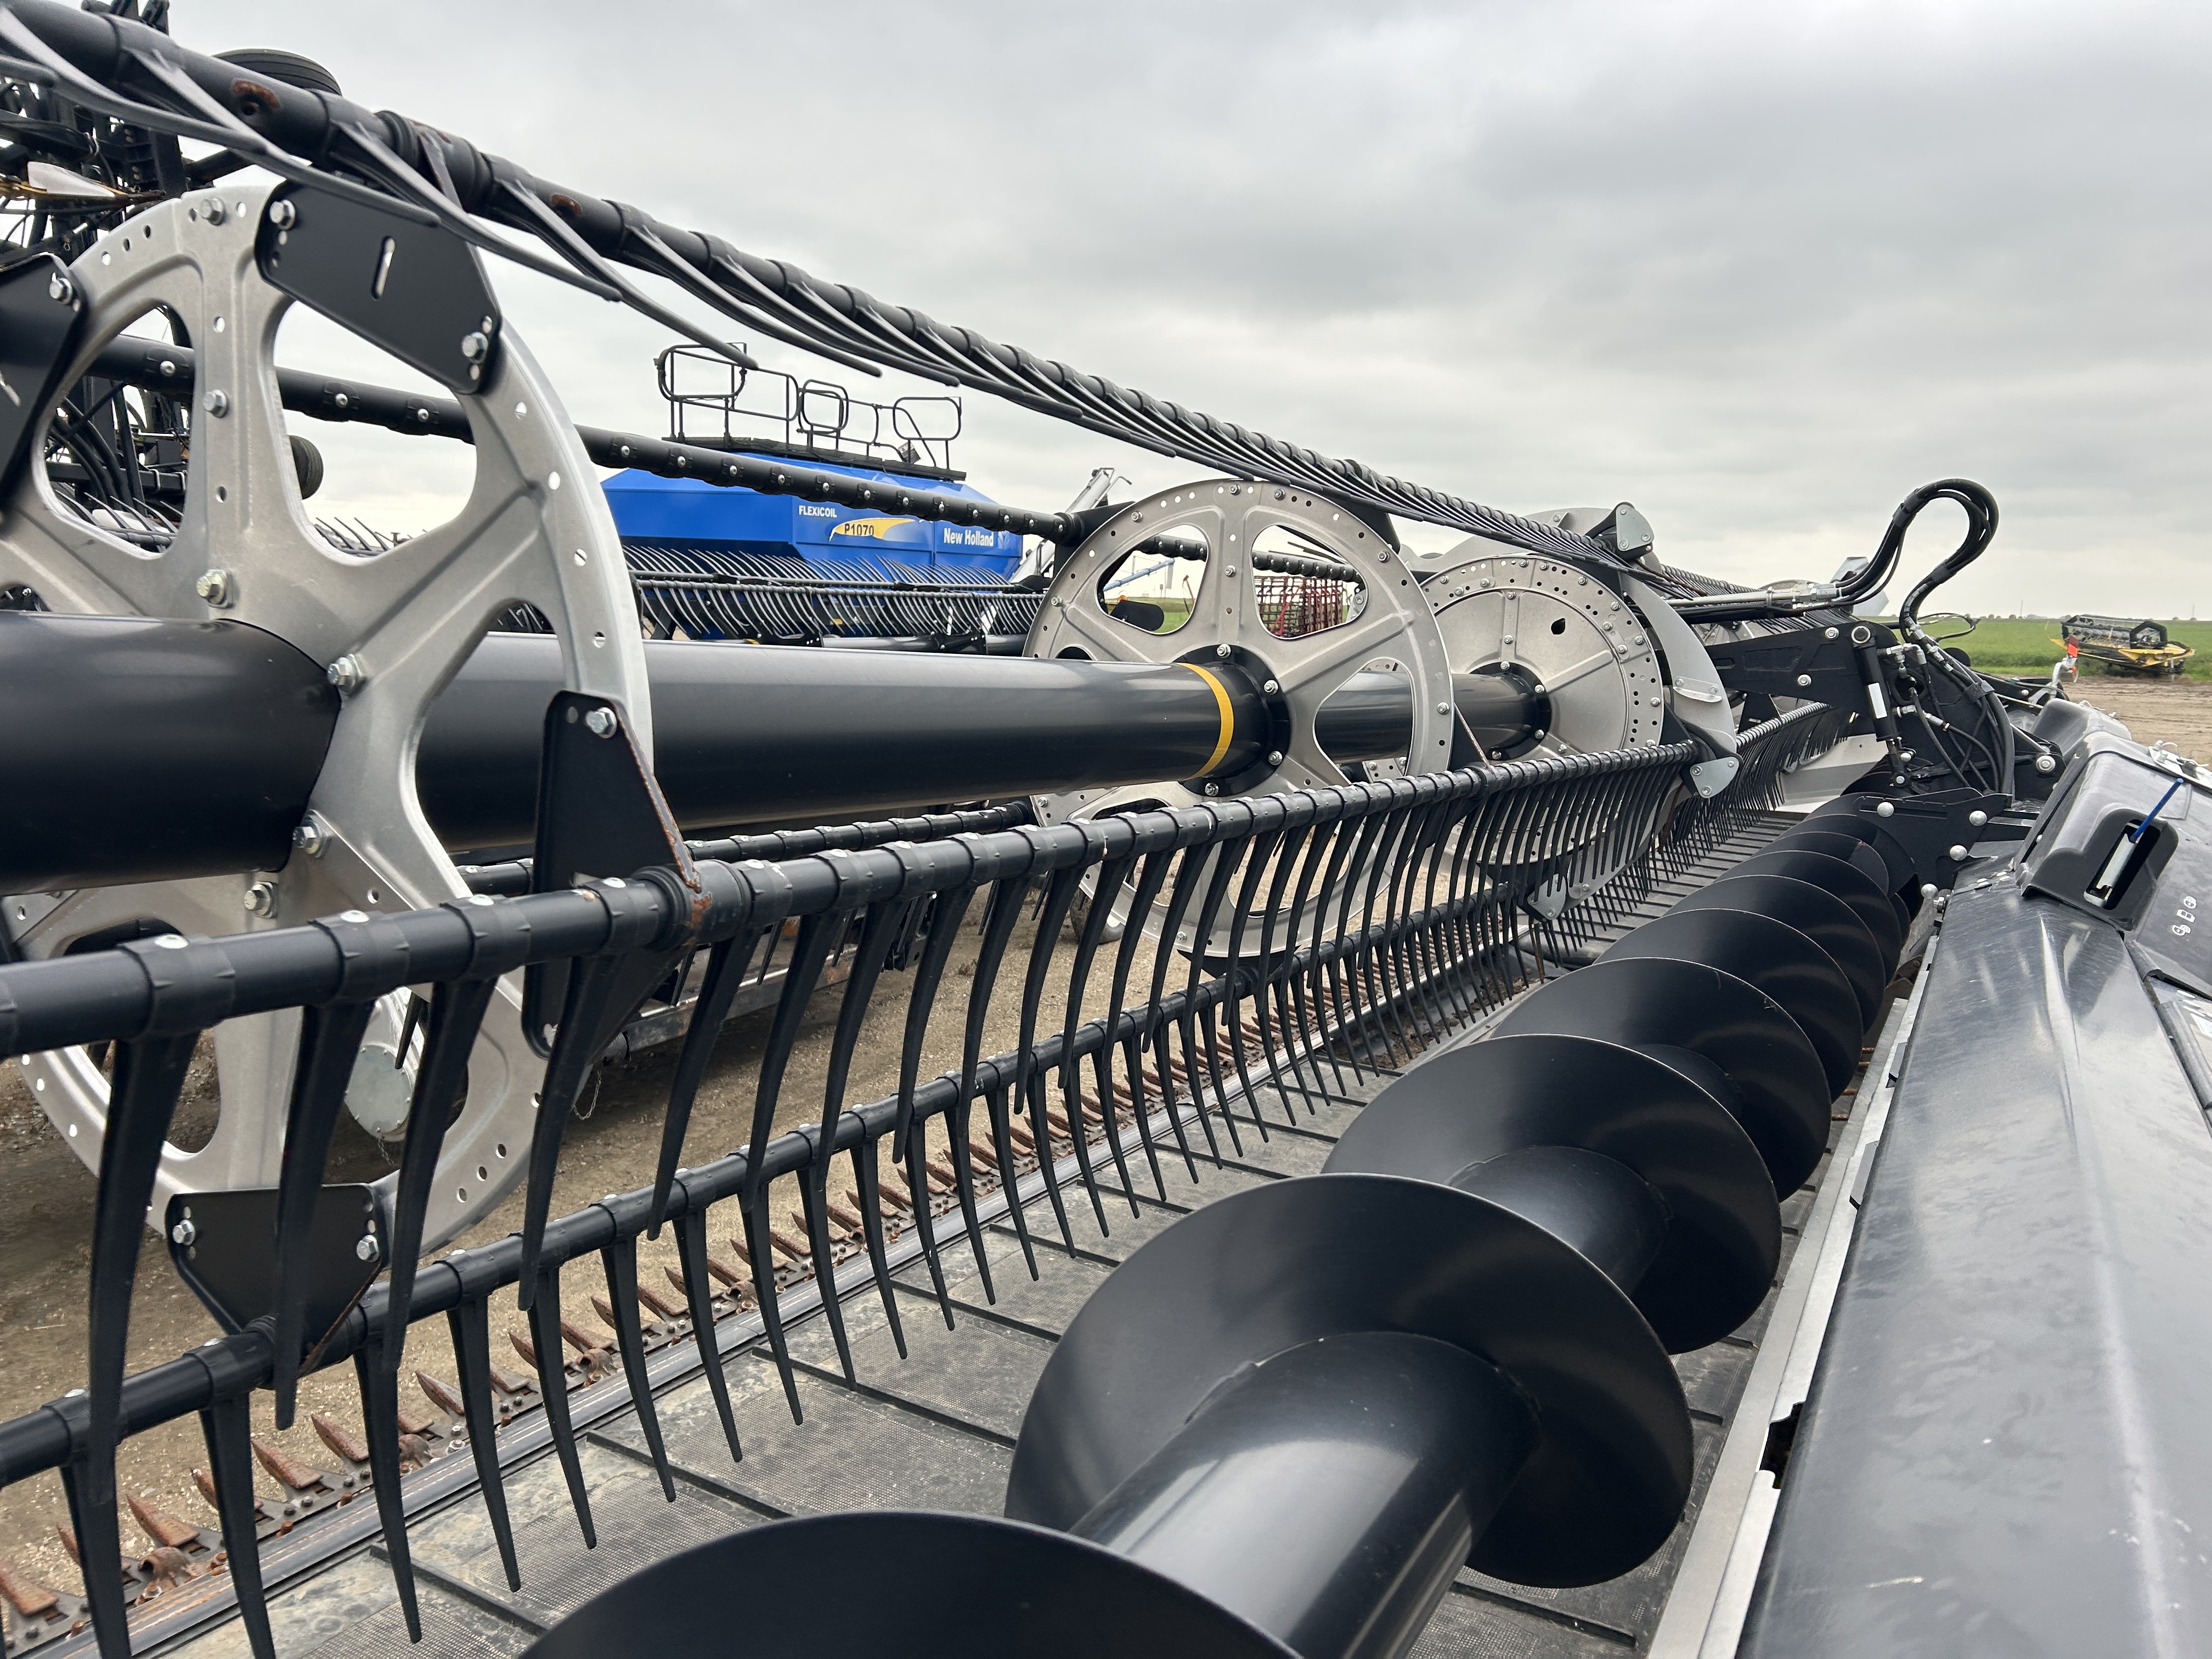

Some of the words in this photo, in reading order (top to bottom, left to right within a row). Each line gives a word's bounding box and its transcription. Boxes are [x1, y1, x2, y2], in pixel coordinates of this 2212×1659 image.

[799, 505, 837, 518] FLEXICOIL
[844, 523, 874, 535] P1070
[944, 528, 963, 544] New
[964, 529, 994, 547] Holland
